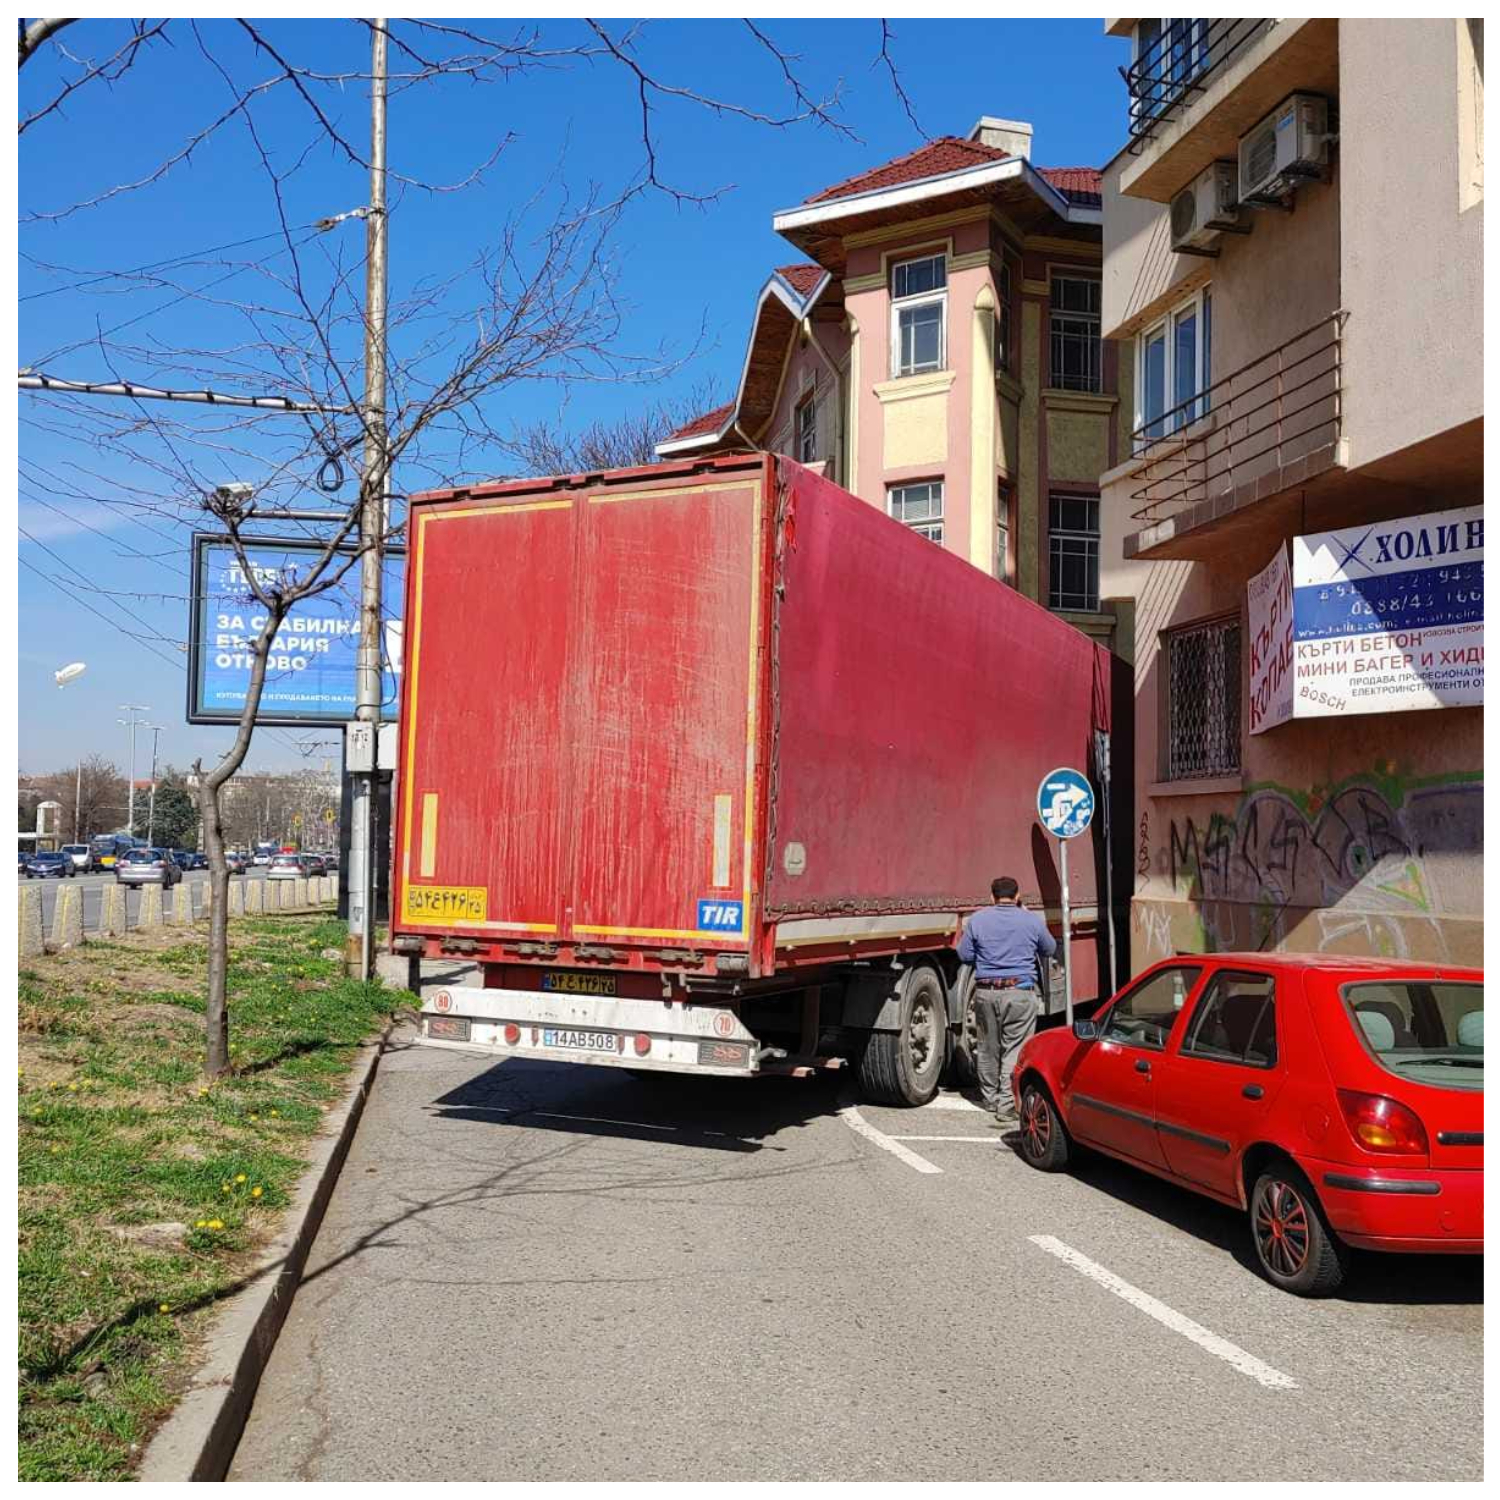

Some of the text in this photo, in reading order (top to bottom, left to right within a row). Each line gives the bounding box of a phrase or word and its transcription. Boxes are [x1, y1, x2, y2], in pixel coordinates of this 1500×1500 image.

[216, 615, 361, 634] ЗА САБИЛНА
[1298, 632, 1423, 658] КЪРТИ БЕТОН
[1297, 660, 1348, 678] МИНИ
[1354, 654, 1414, 673] БАГЕР
[1421, 652, 1433, 666] И
[1299, 686, 1347, 710] BOSCH
[702, 905, 740, 925] TIR
[553, 1030, 614, 1050] 14AB508
